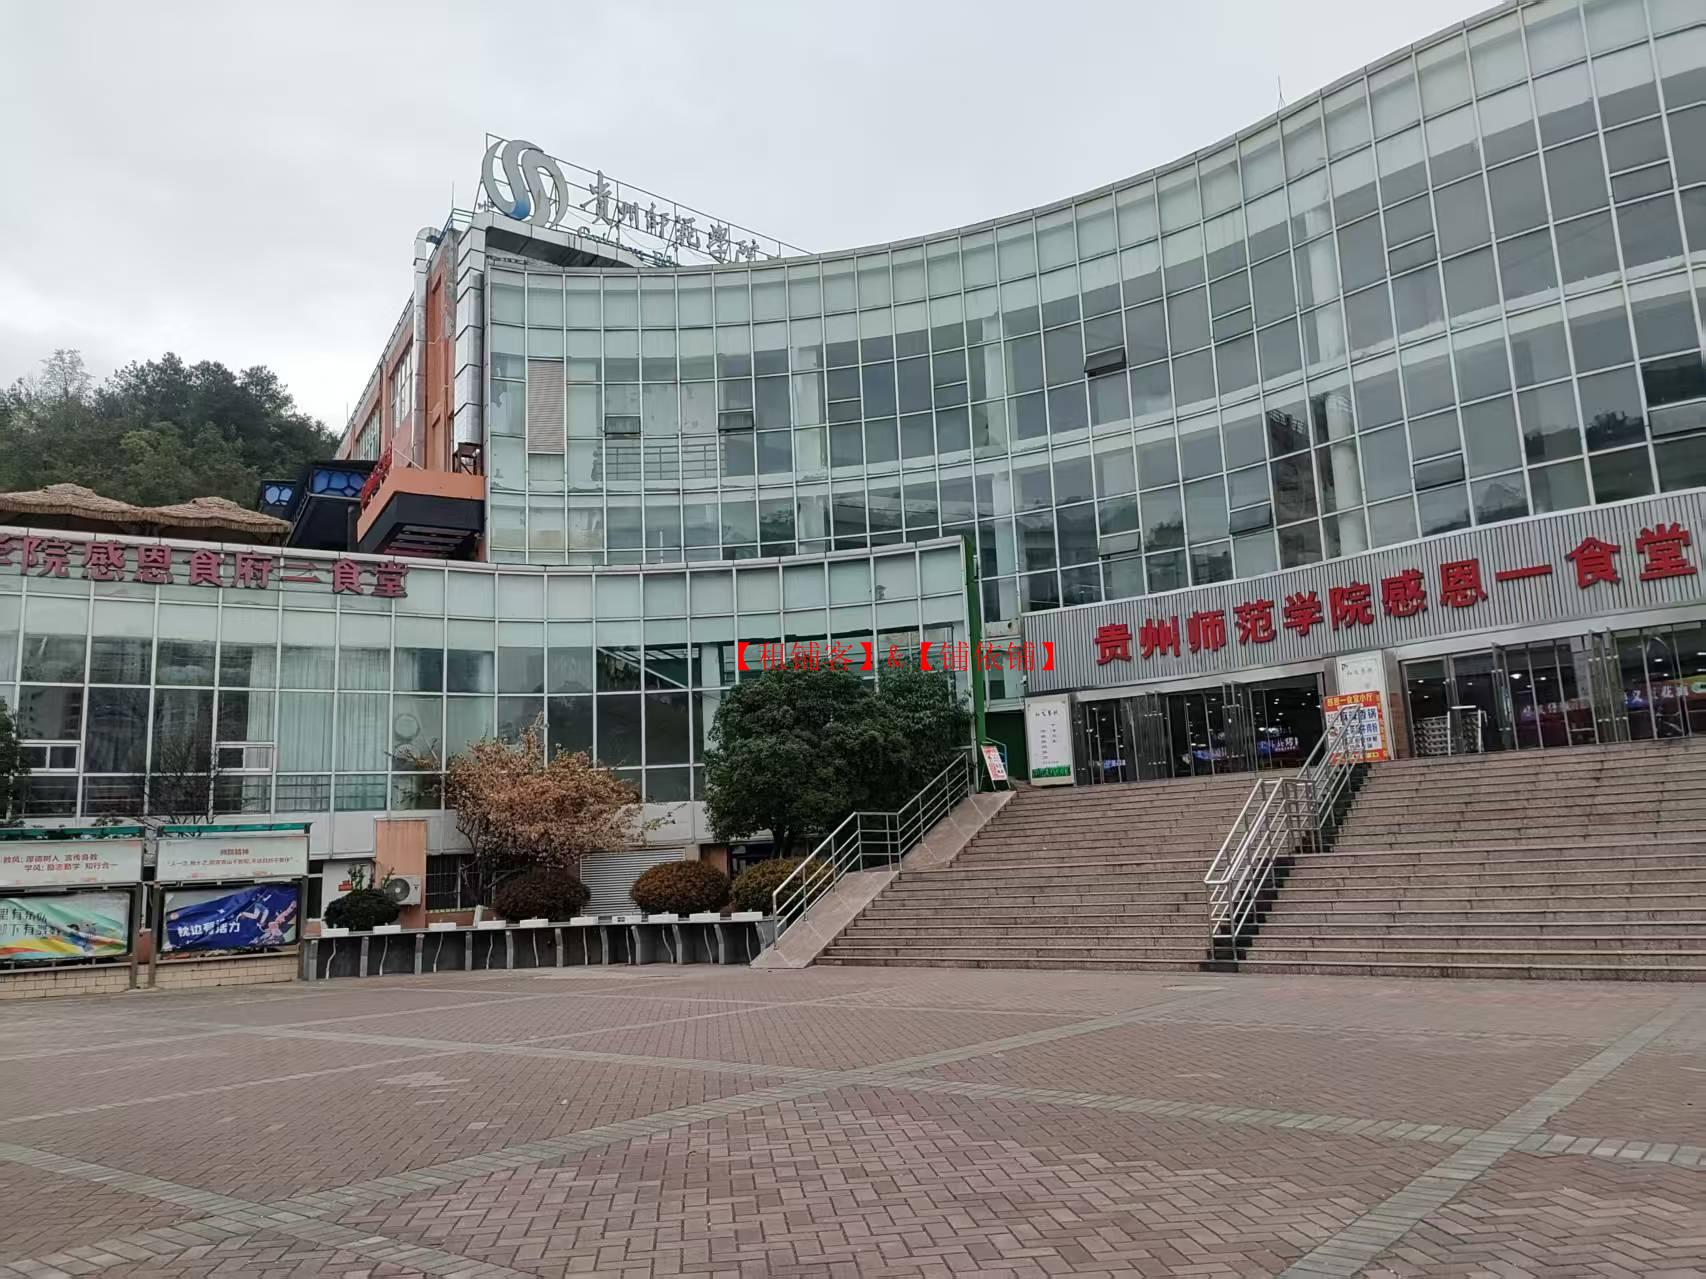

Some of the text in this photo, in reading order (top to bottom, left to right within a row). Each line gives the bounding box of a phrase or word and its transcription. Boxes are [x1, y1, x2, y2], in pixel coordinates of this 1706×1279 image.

[1094, 522, 1697, 666] 贵州师范学院感恩一食堂
